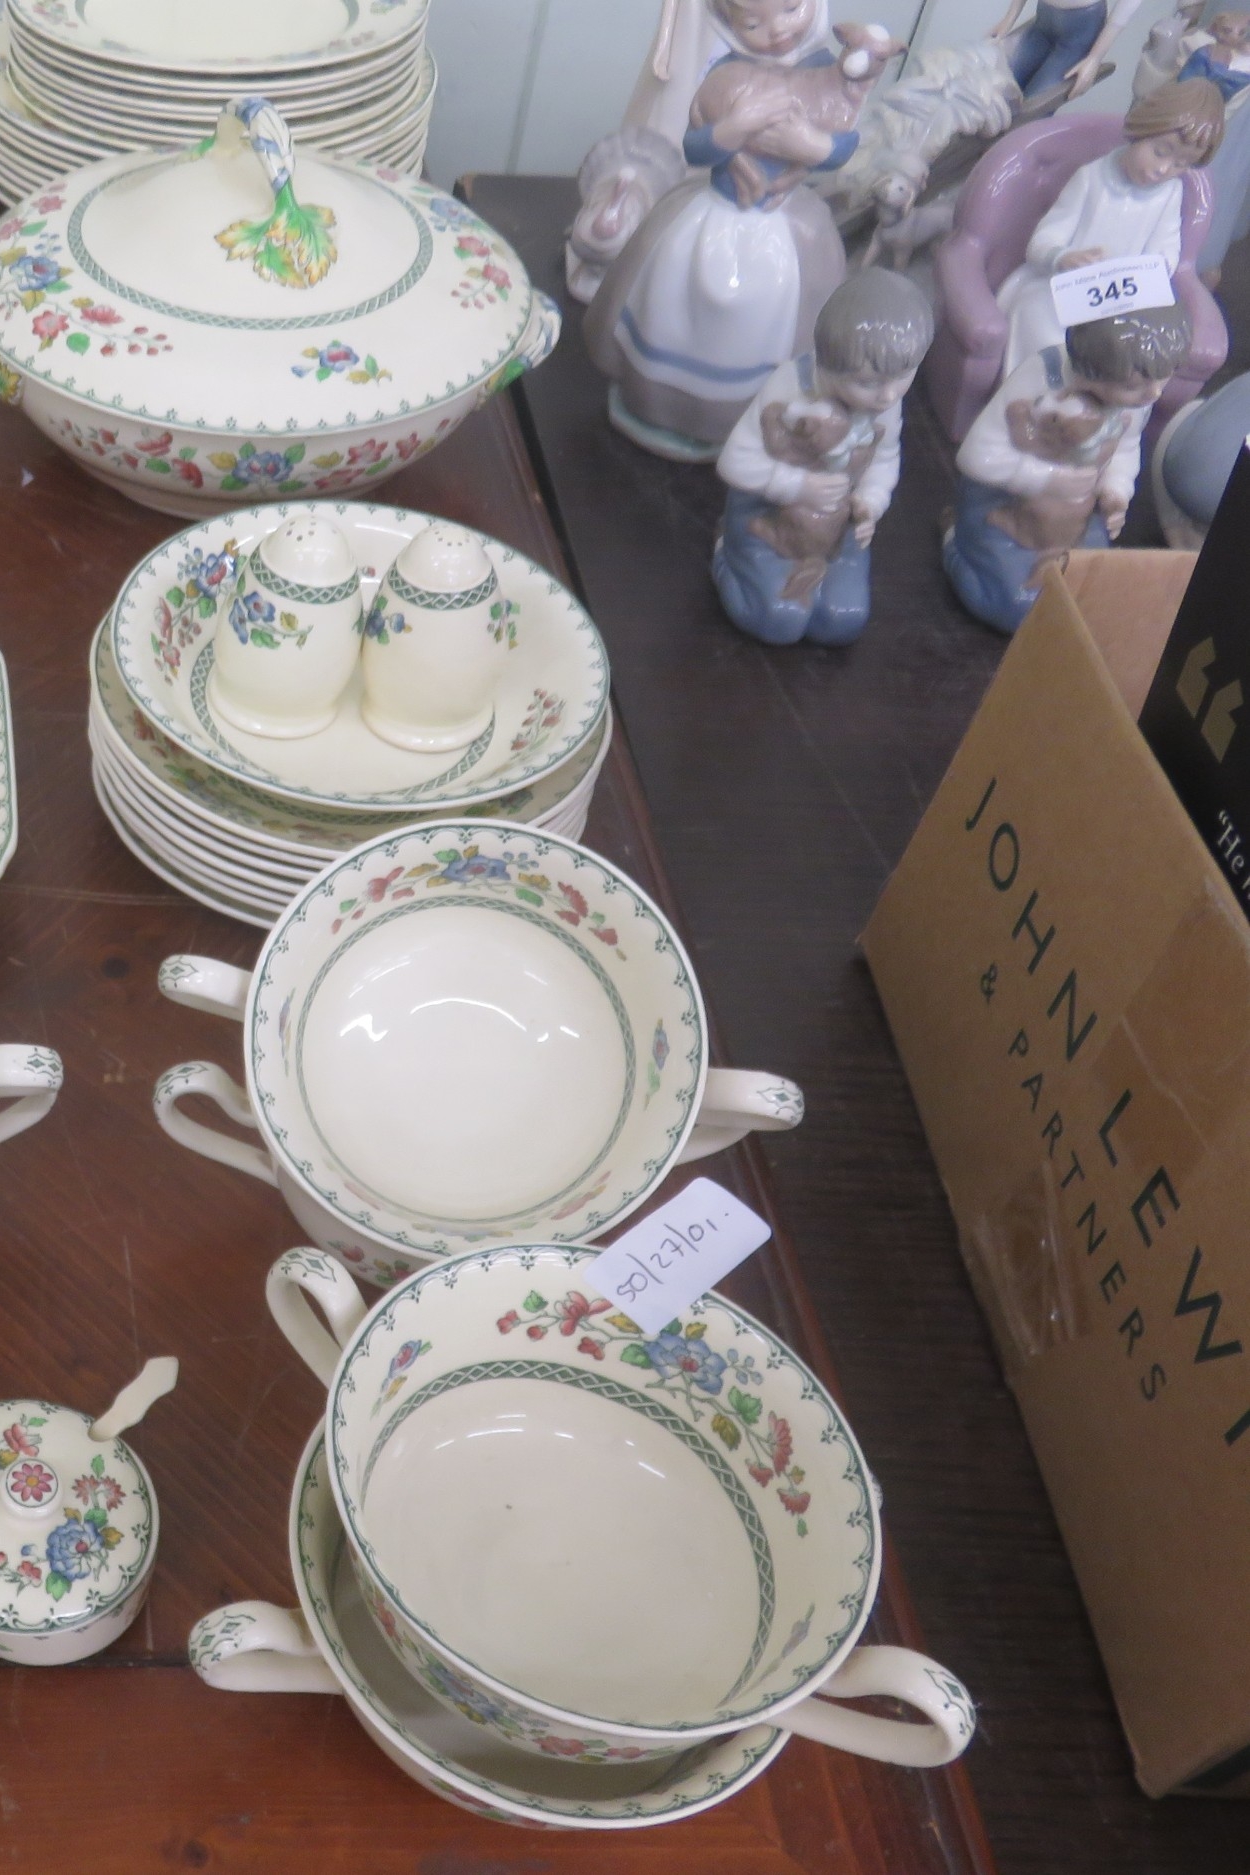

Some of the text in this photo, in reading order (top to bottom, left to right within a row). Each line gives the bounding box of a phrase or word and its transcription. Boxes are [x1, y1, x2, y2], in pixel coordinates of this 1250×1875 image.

[1087, 277, 1138, 307] 345
[965, 777, 1098, 1063] JOHN
[980, 962, 1168, 1401] & PARTNERS
